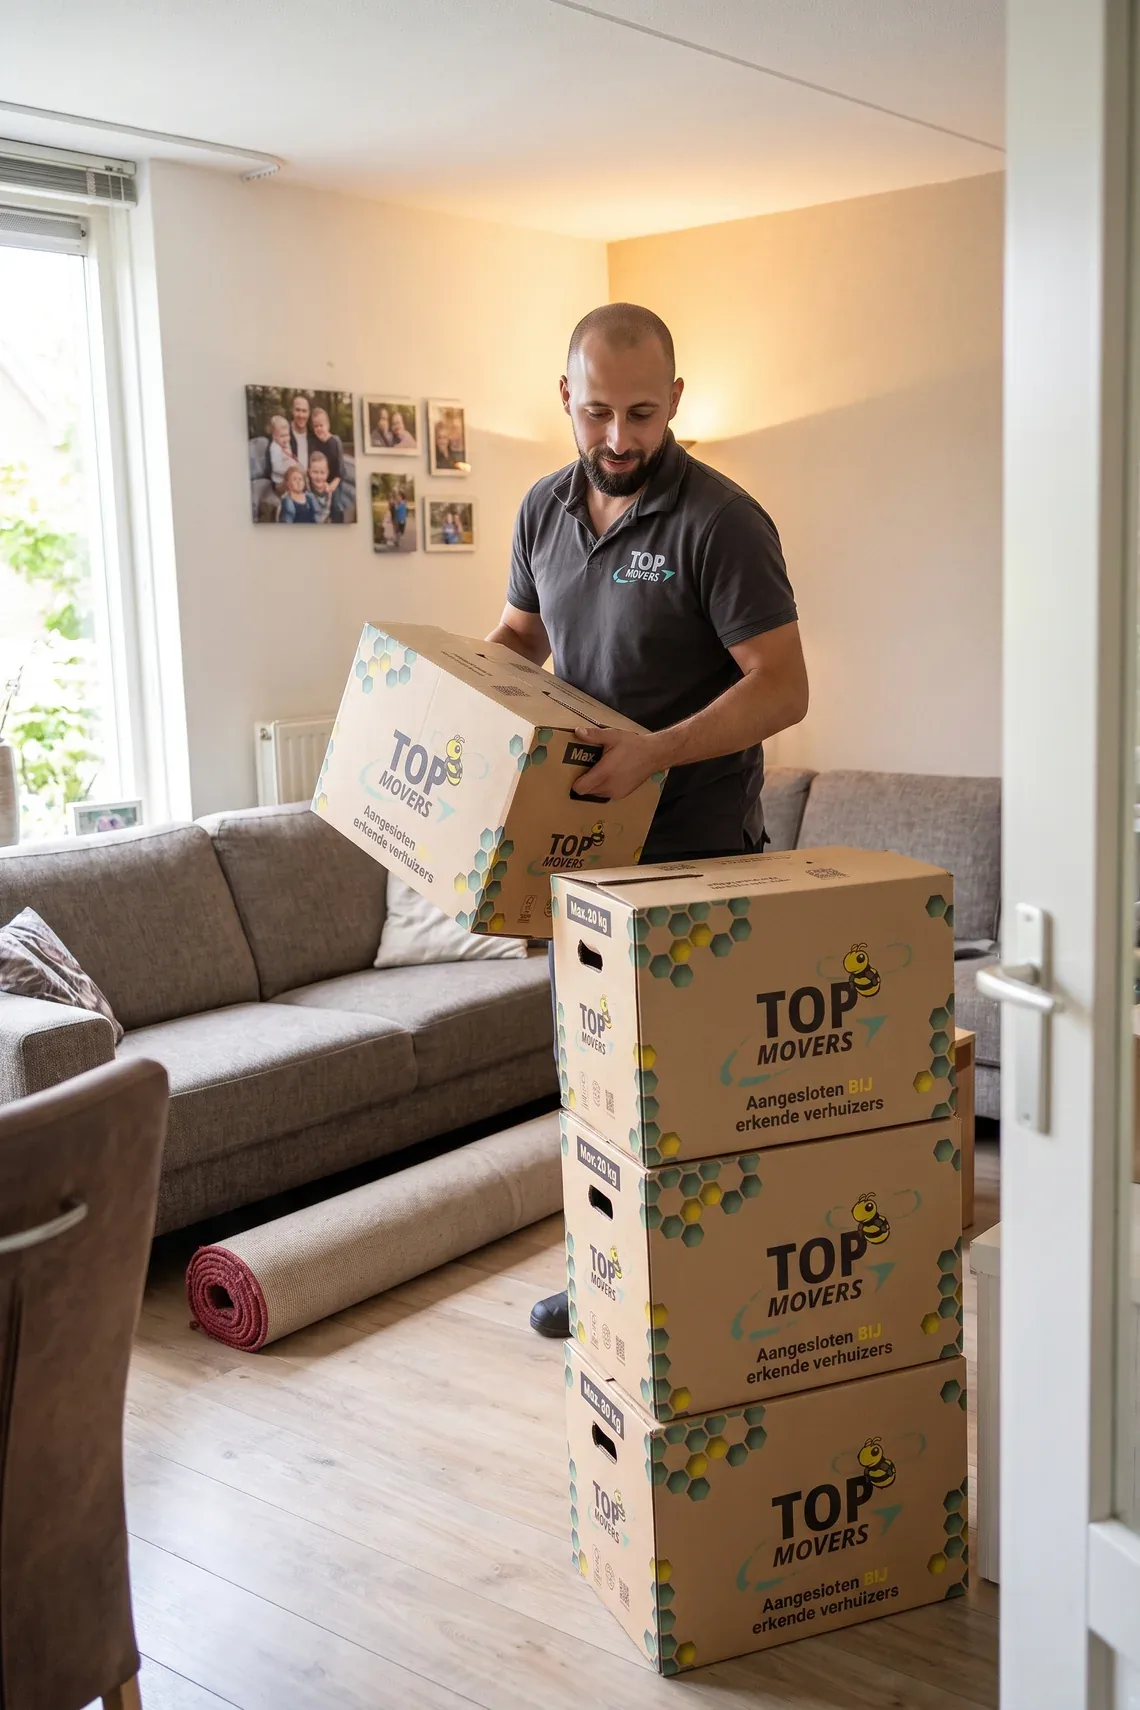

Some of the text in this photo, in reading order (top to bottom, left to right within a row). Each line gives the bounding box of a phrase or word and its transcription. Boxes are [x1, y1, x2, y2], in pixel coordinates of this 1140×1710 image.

[625, 569, 660, 582] MOVERS
[630, 550, 666, 572] TOP
[389, 729, 447, 796] TOP
[570, 748, 596, 763] Max.
[378, 770, 433, 818] MOVERS
[353, 818, 388, 849] erkende
[549, 833, 593, 857] TOP
[541, 856, 585, 869] MOVERS
[597, 910, 608, 933] kg
[579, 1002, 606, 1038] TOP
[756, 981, 858, 1039] TOP
[581, 1031, 606, 1055] MOVERS
[757, 1031, 853, 1066] MOVERS
[746, 1077, 873, 1111] Aangesloten BIJ
[735, 1098, 884, 1132] erkende verhuizers
[607, 1162, 617, 1187] kg
[590, 1244, 616, 1285] TOP
[766, 1230, 868, 1292] TOP
[590, 1272, 616, 1302] MOVERS
[767, 1279, 863, 1318] MOVERS
[756, 1323, 882, 1363] Aangesloten BIJ
[746, 1342, 893, 1384] erkende verhuizers
[592, 1480, 620, 1526] TOP
[771, 1475, 874, 1540] TOP
[594, 1508, 620, 1544] MOVERS
[772, 1523, 869, 1568] MOVERS
[863, 1567, 888, 1586] BIJ
[752, 1607, 816, 1634] erkende
